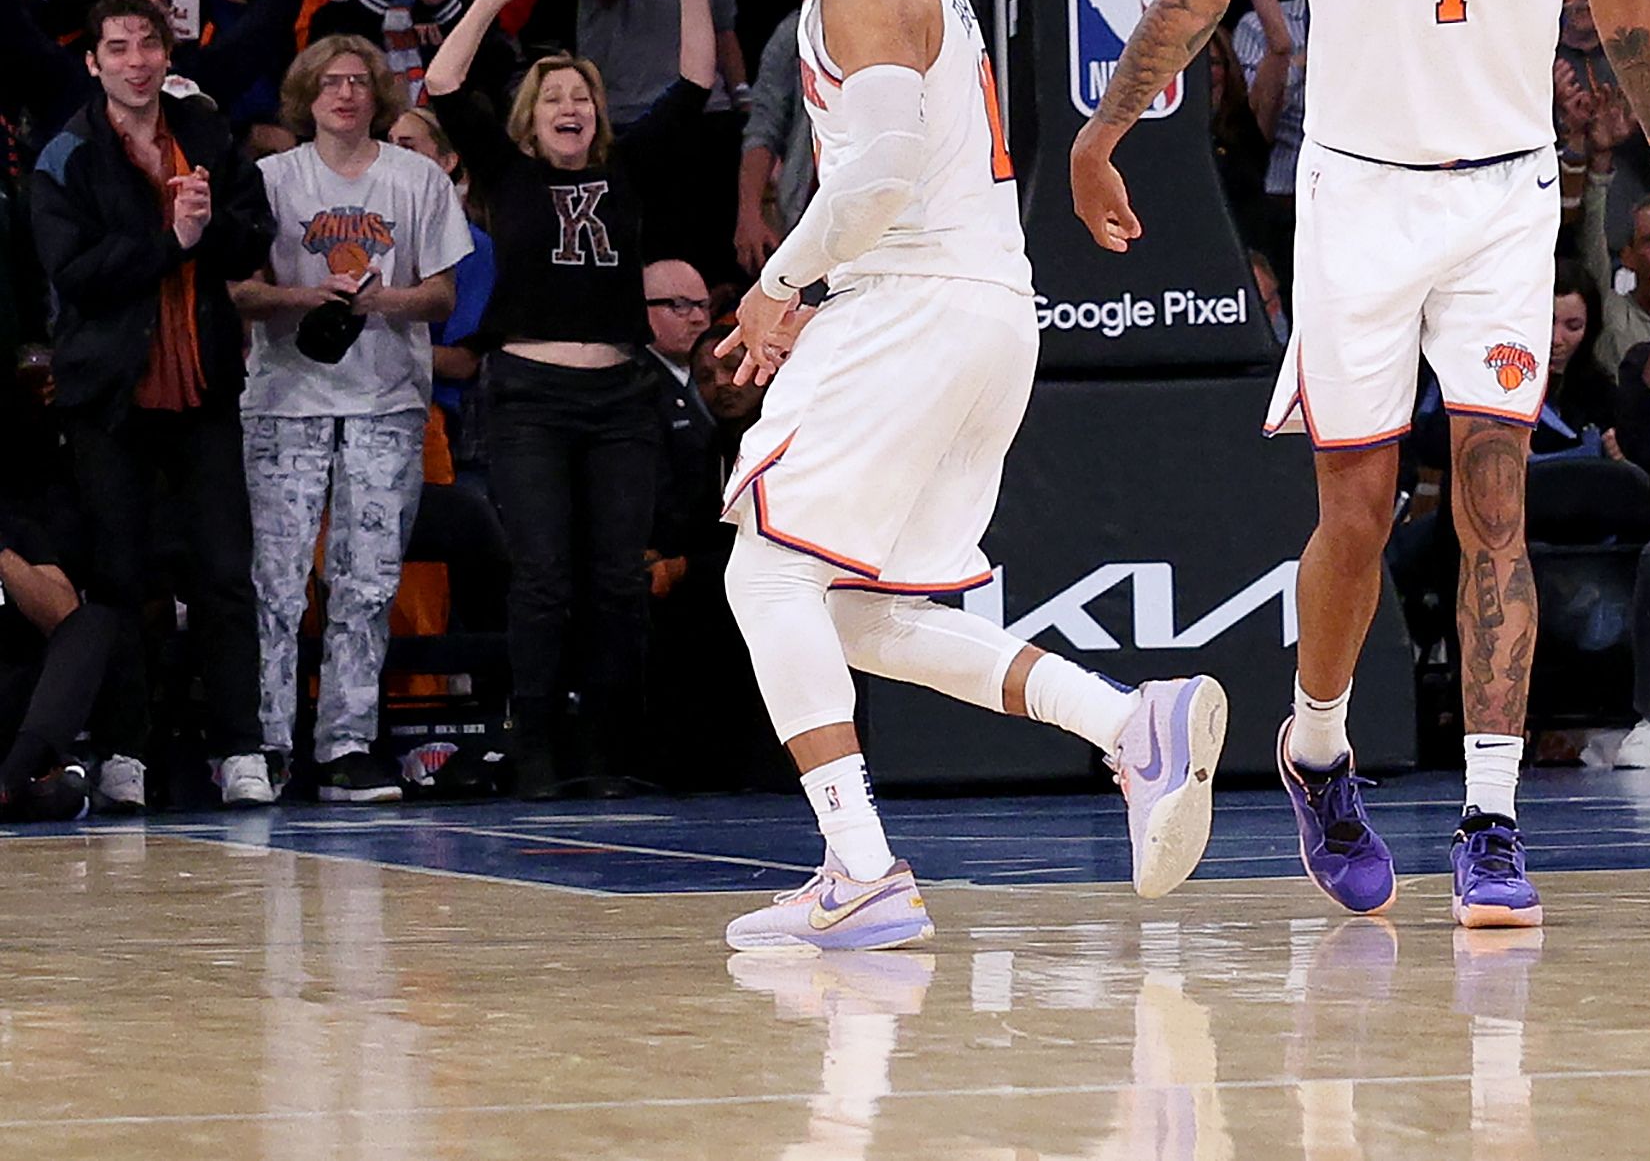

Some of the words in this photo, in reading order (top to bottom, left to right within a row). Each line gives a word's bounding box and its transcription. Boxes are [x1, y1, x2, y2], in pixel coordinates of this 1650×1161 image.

[302, 210, 396, 252] KNICKS
[547, 179, 619, 267] K
[1163, 288, 1247, 326] Pixel
